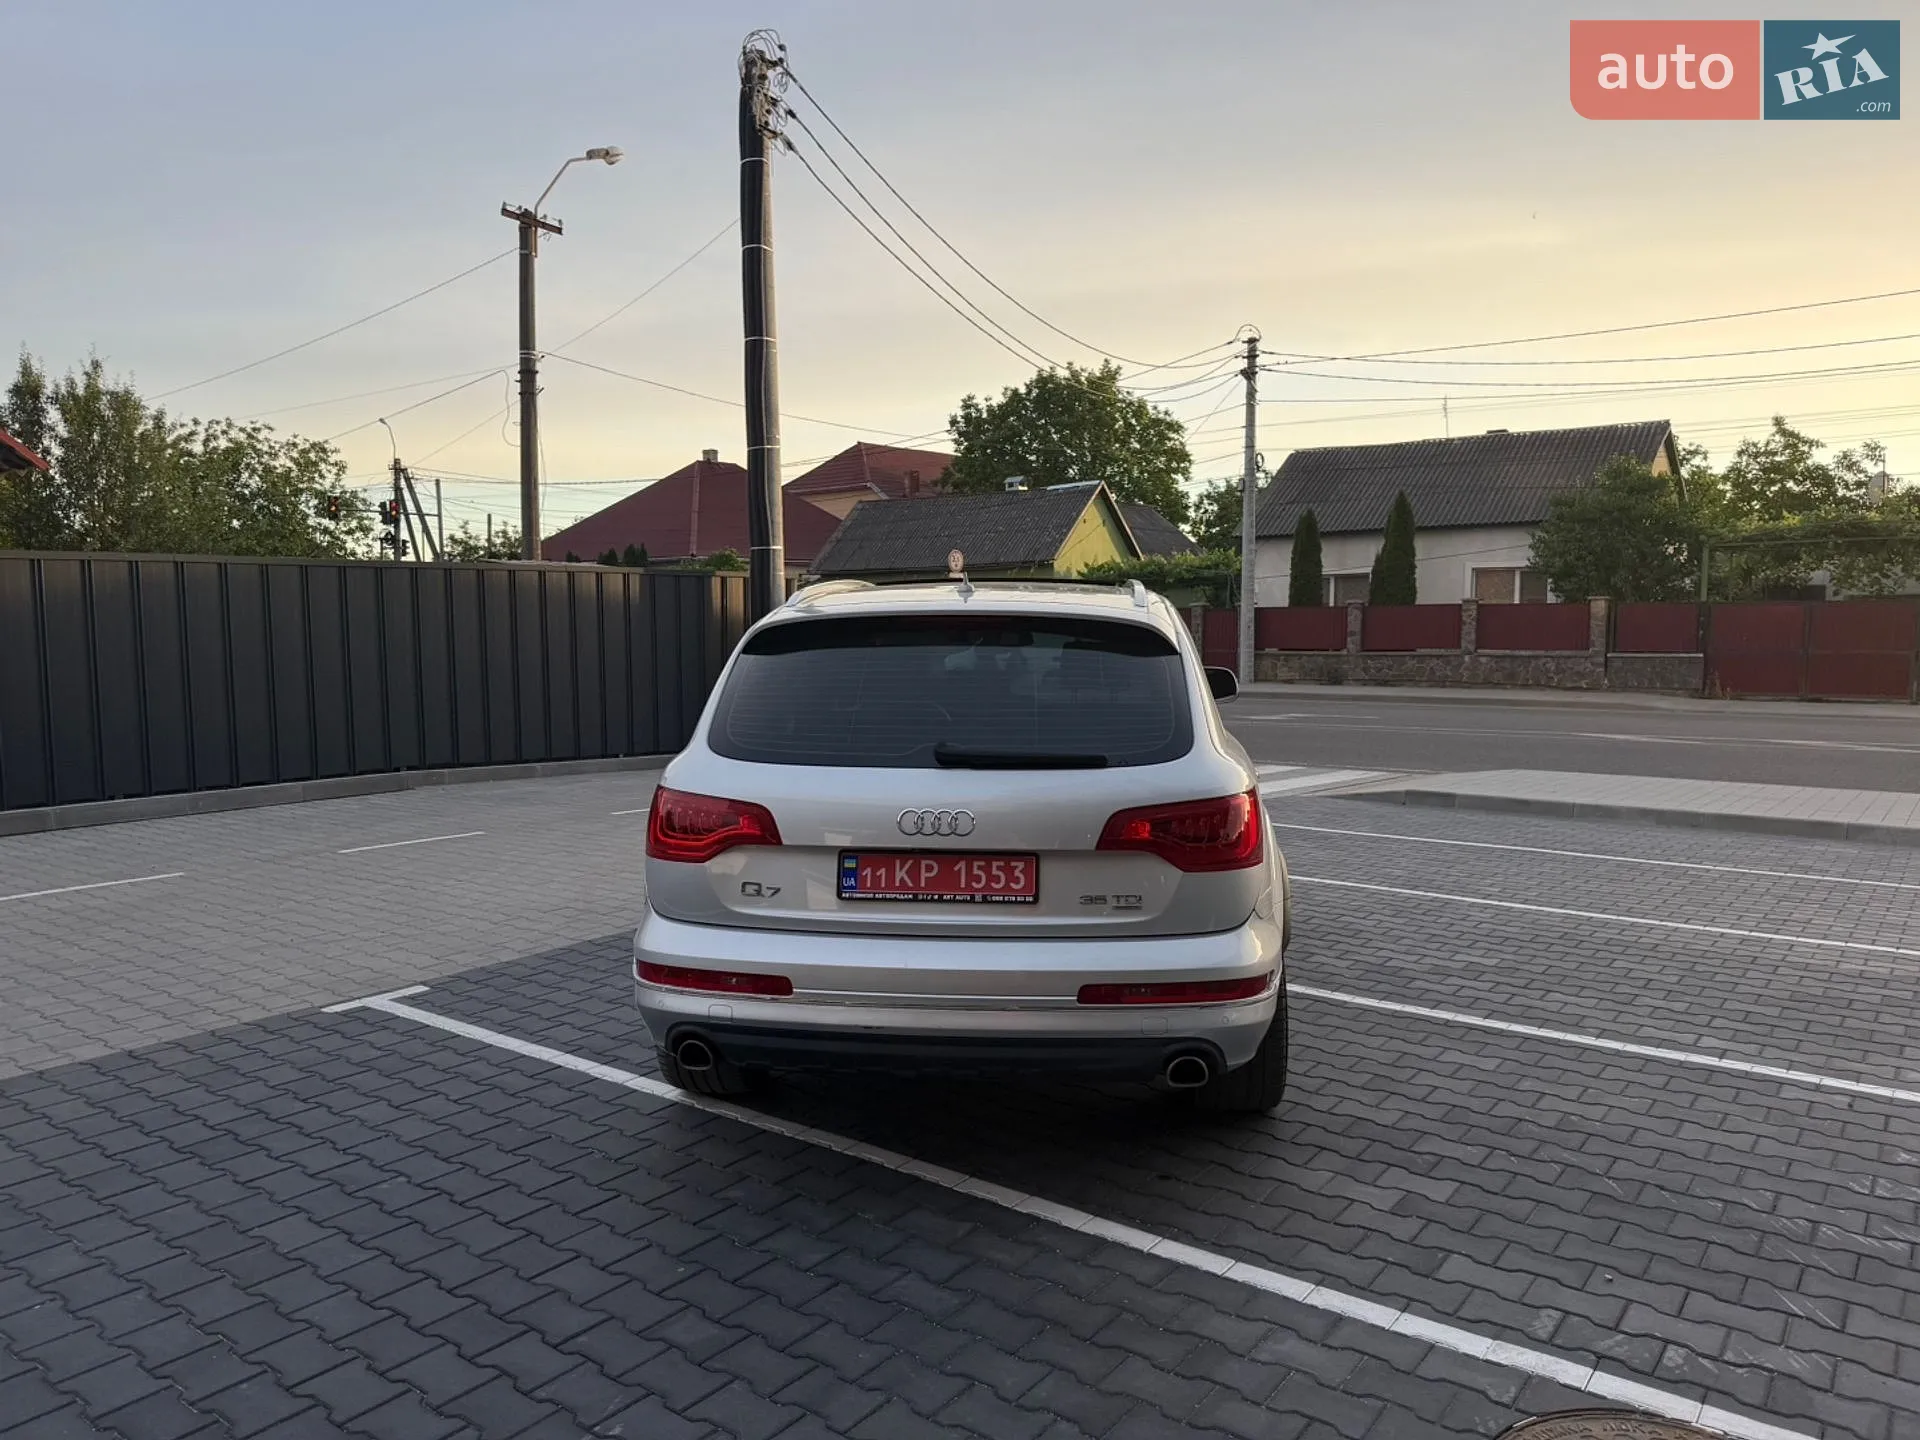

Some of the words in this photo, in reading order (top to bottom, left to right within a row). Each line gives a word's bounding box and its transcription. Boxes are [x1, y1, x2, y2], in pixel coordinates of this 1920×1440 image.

[842, 877, 856, 887] UA
[953, 860, 1025, 890] 1553
[741, 881, 782, 899] Q7
[1111, 894, 1143, 905] TDI
